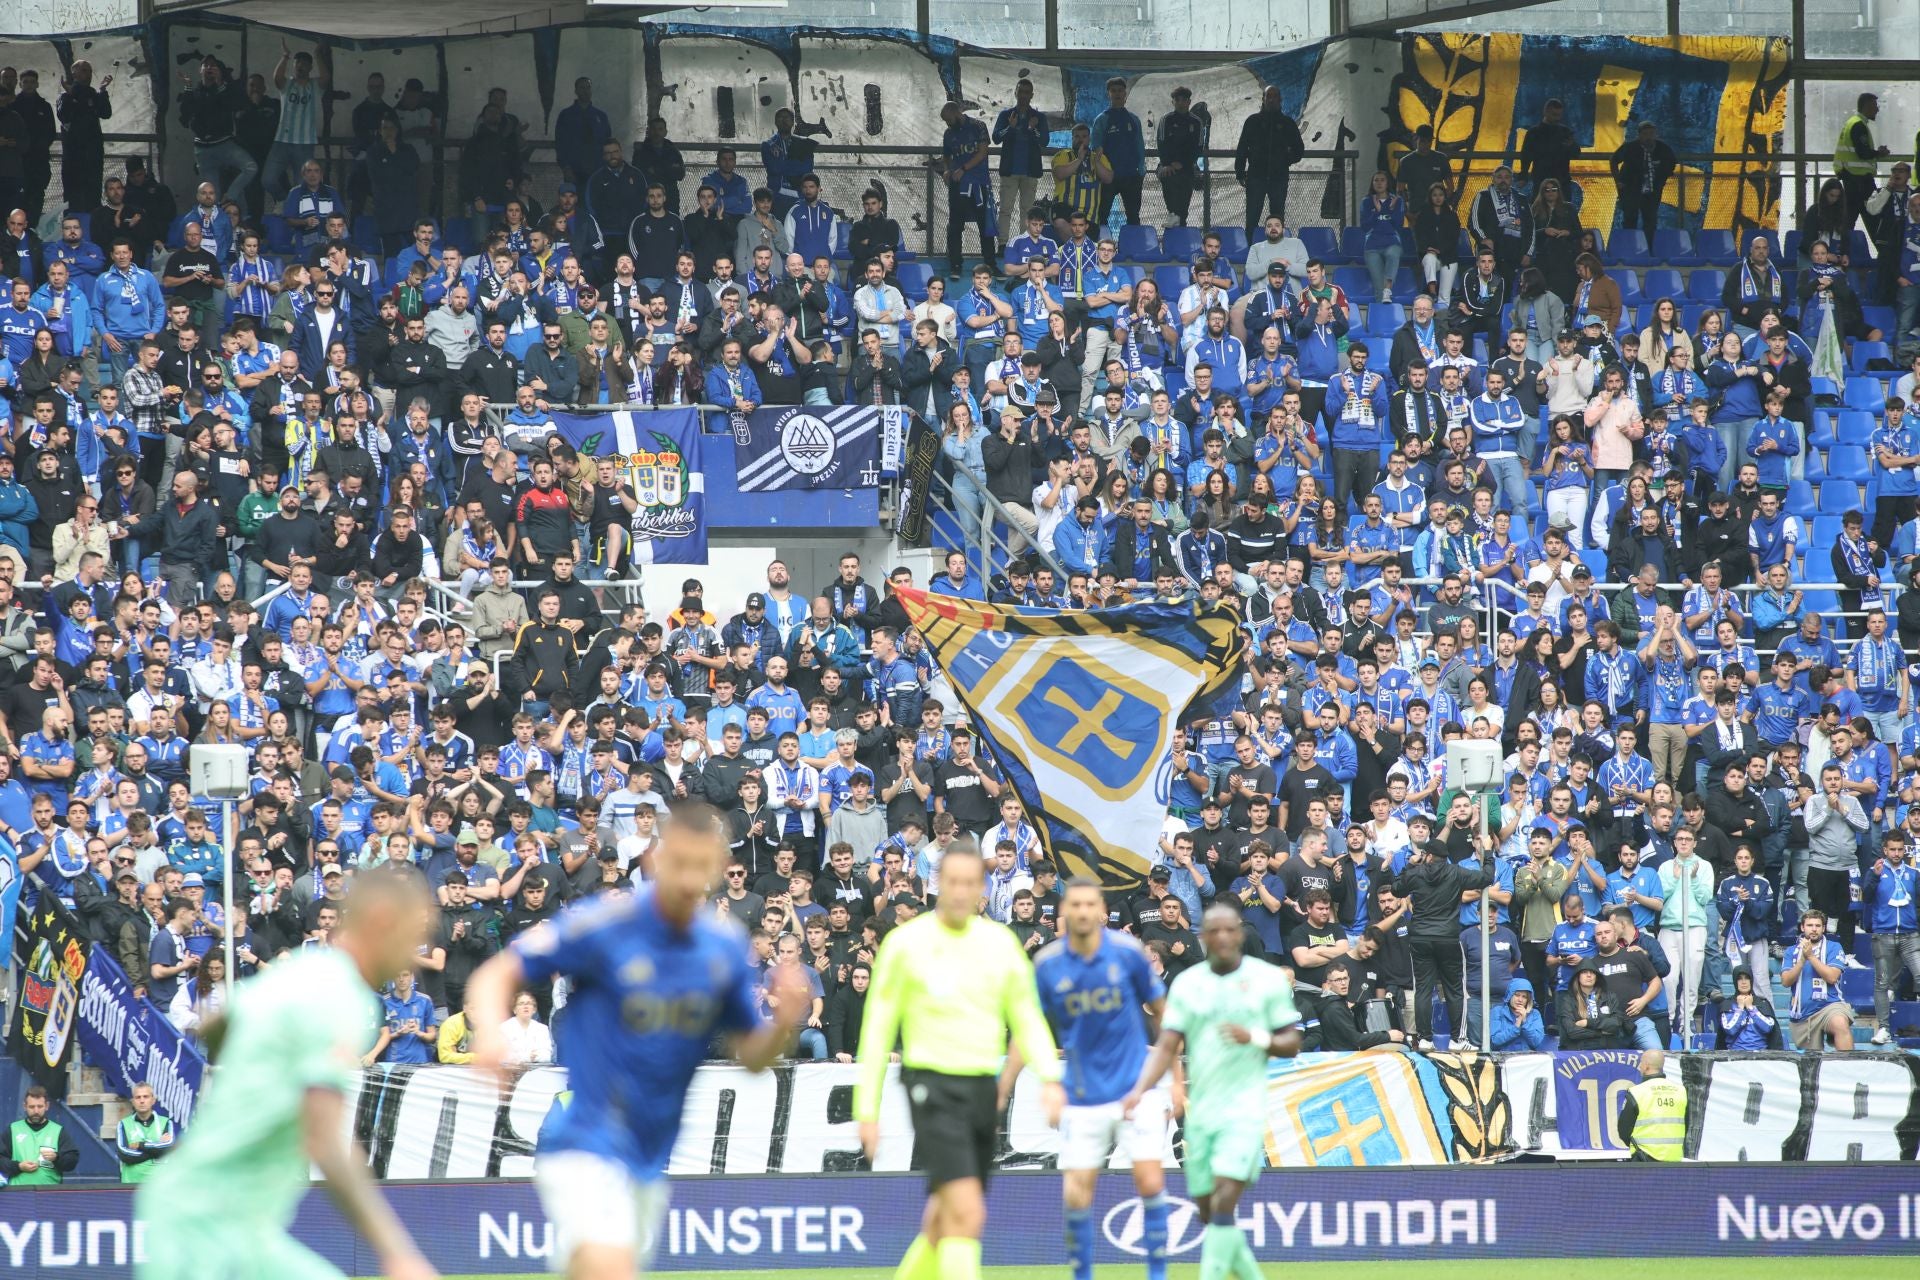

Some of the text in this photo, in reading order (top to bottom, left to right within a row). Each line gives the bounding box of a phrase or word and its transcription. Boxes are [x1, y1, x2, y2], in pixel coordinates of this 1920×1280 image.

[4, 325, 36, 336] DIGI
[774, 408, 798, 432] OVIEDO
[886, 409, 900, 457] Spezial
[767, 706, 796, 719] DIGI
[1765, 704, 1794, 718] DIGI
[1558, 940, 1588, 950] DIGI
[1557, 1050, 1642, 1080] VILLAVER
[1657, 1097, 1674, 1107] 048
[1717, 1194, 1885, 1241] Nuevo
[668, 1206, 866, 1255] INSTER
